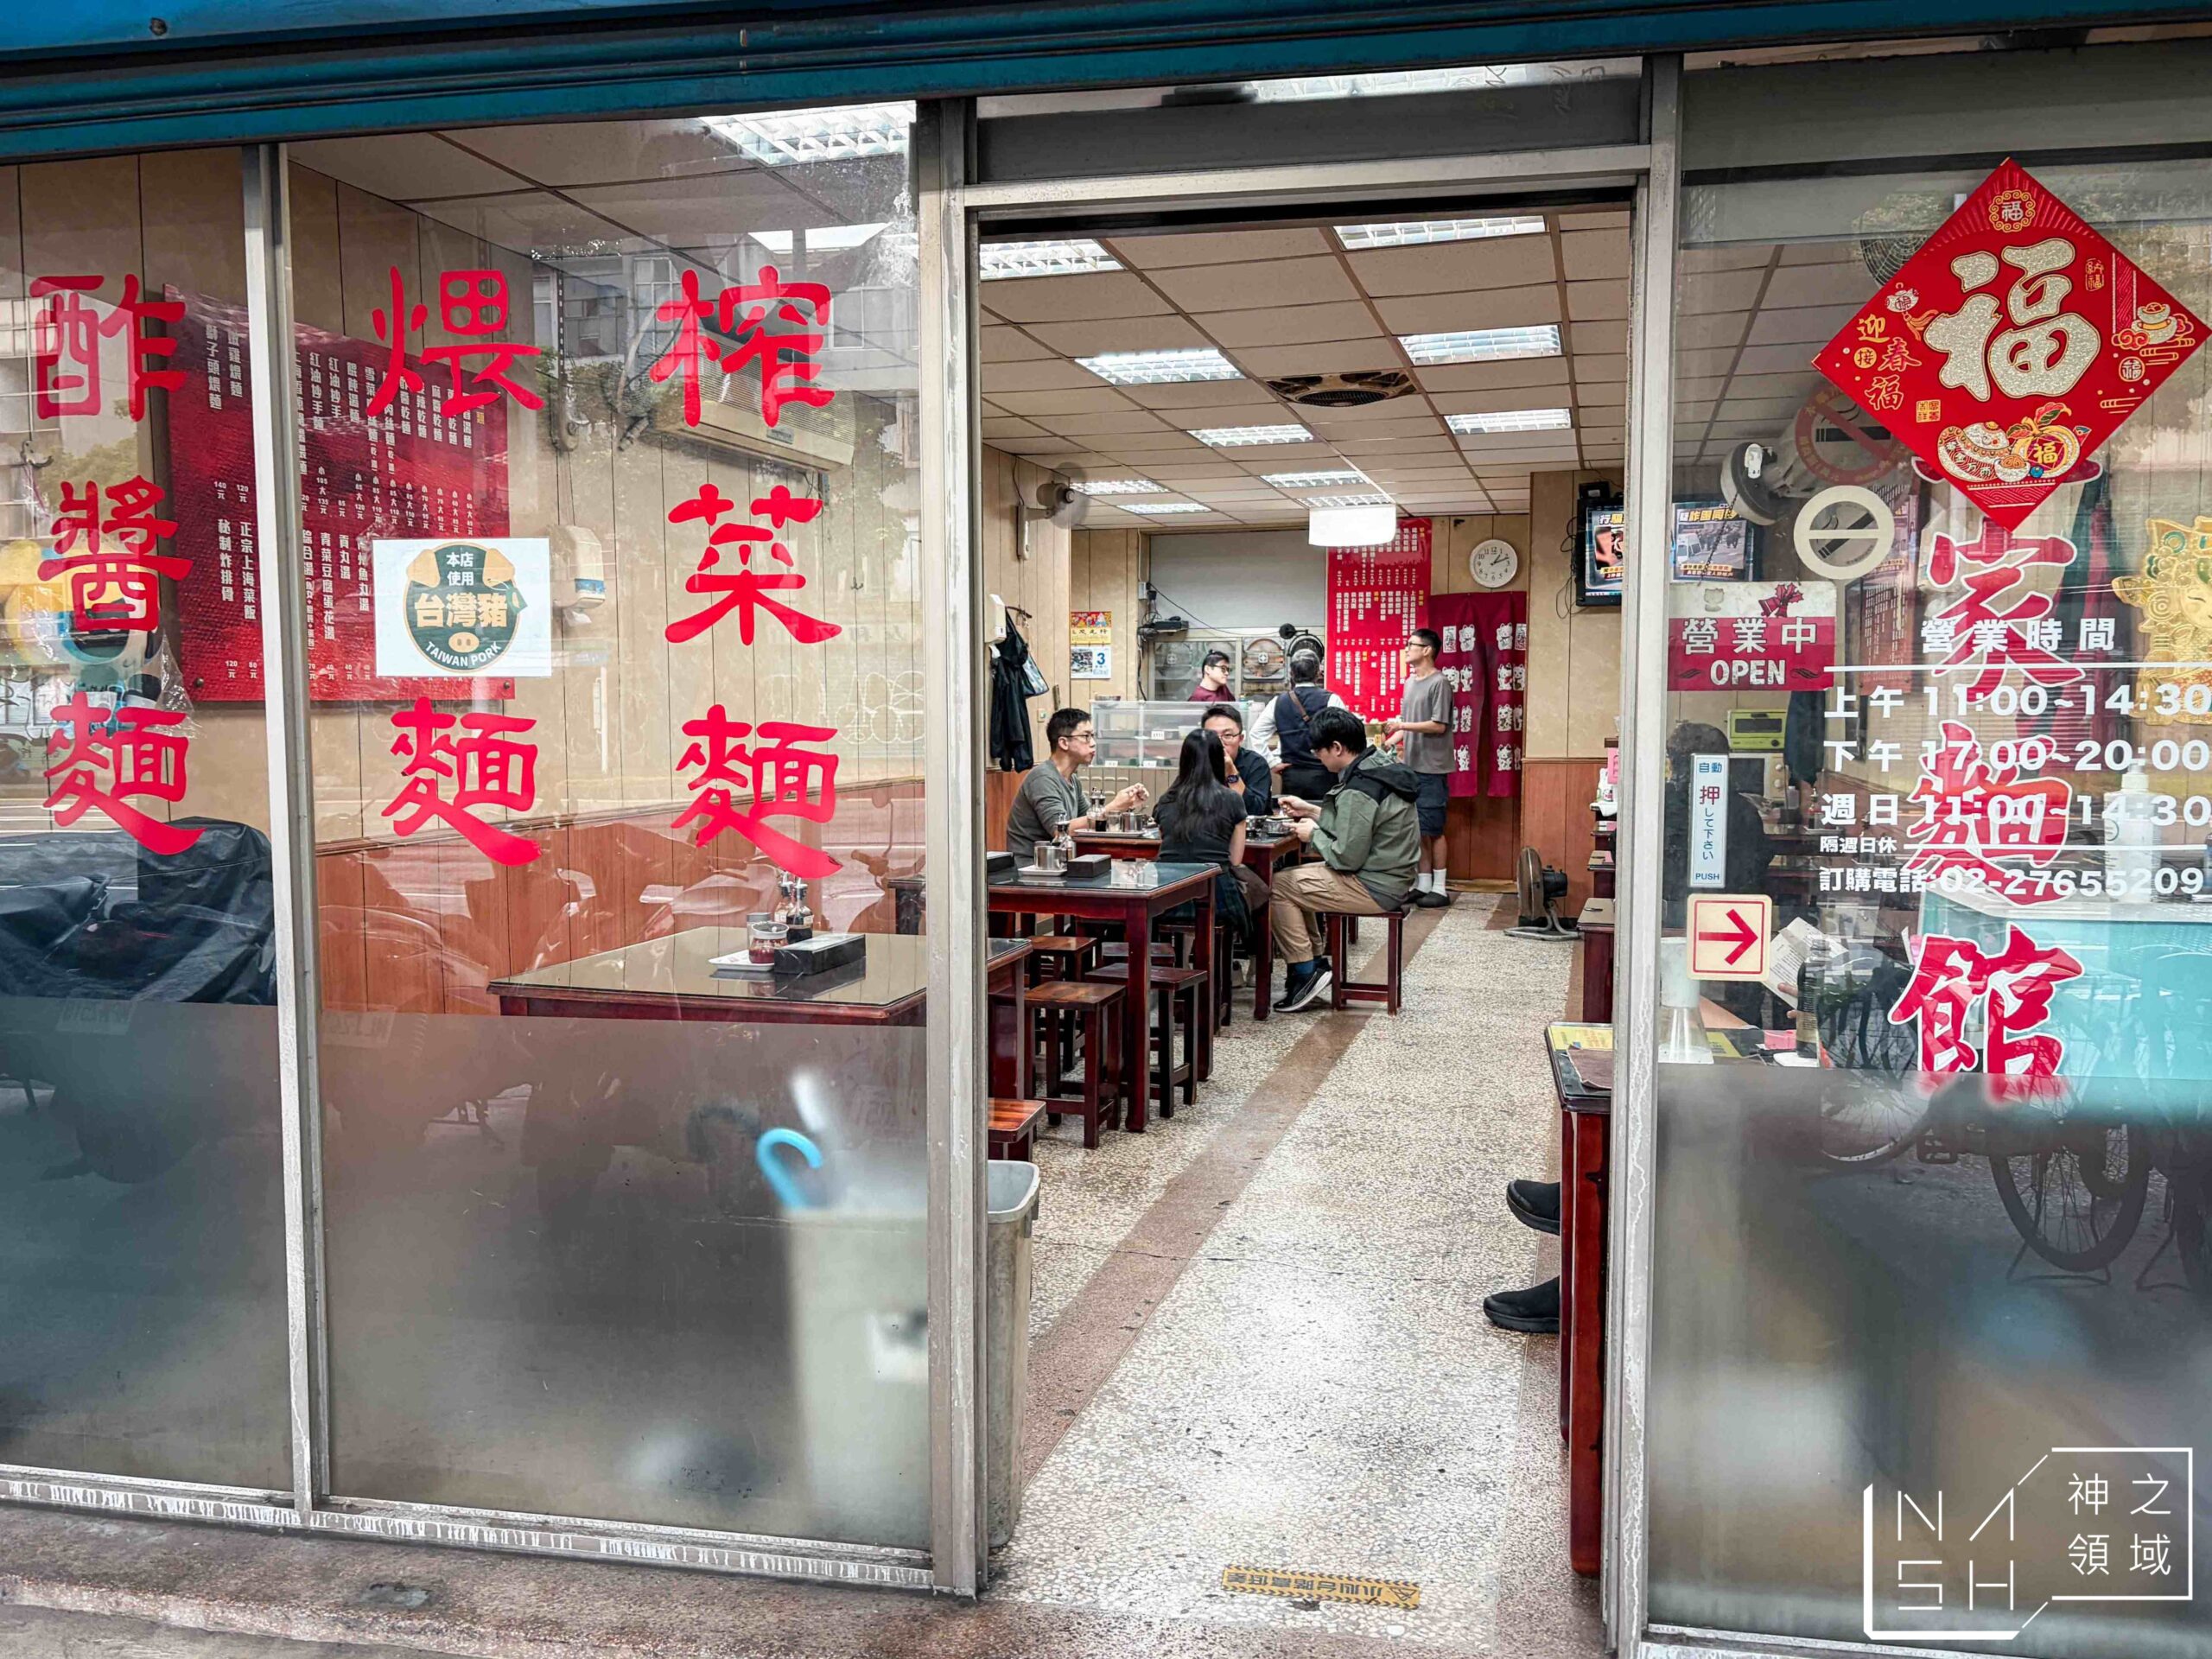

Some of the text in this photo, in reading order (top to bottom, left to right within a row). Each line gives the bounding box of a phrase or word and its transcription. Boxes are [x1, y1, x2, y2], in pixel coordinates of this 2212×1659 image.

[1923, 238, 2101, 401] 福
[2035, 443, 2058, 464] 福
[239, 521, 257, 620] 正宗上海菜飯
[446, 551, 474, 568] 本店
[650, 266, 843, 879] 榨菜麵
[447, 571, 474, 587] 使用
[415, 592, 508, 627] 台灣豬
[1681, 617, 1817, 655] 營業中
[1921, 617, 2115, 653] 營業時間
[425, 641, 502, 667] TAIWAN PORK
[1710, 658, 1786, 687] OPEN
[1824, 684, 2212, 719] 上午 11:00~14:30
[1699, 762, 1722, 773] 自動
[1824, 740, 2210, 772] 下午 17:00~20:00
[1821, 793, 1898, 826] 週日
[1820, 836, 1897, 854] 隔週日休
